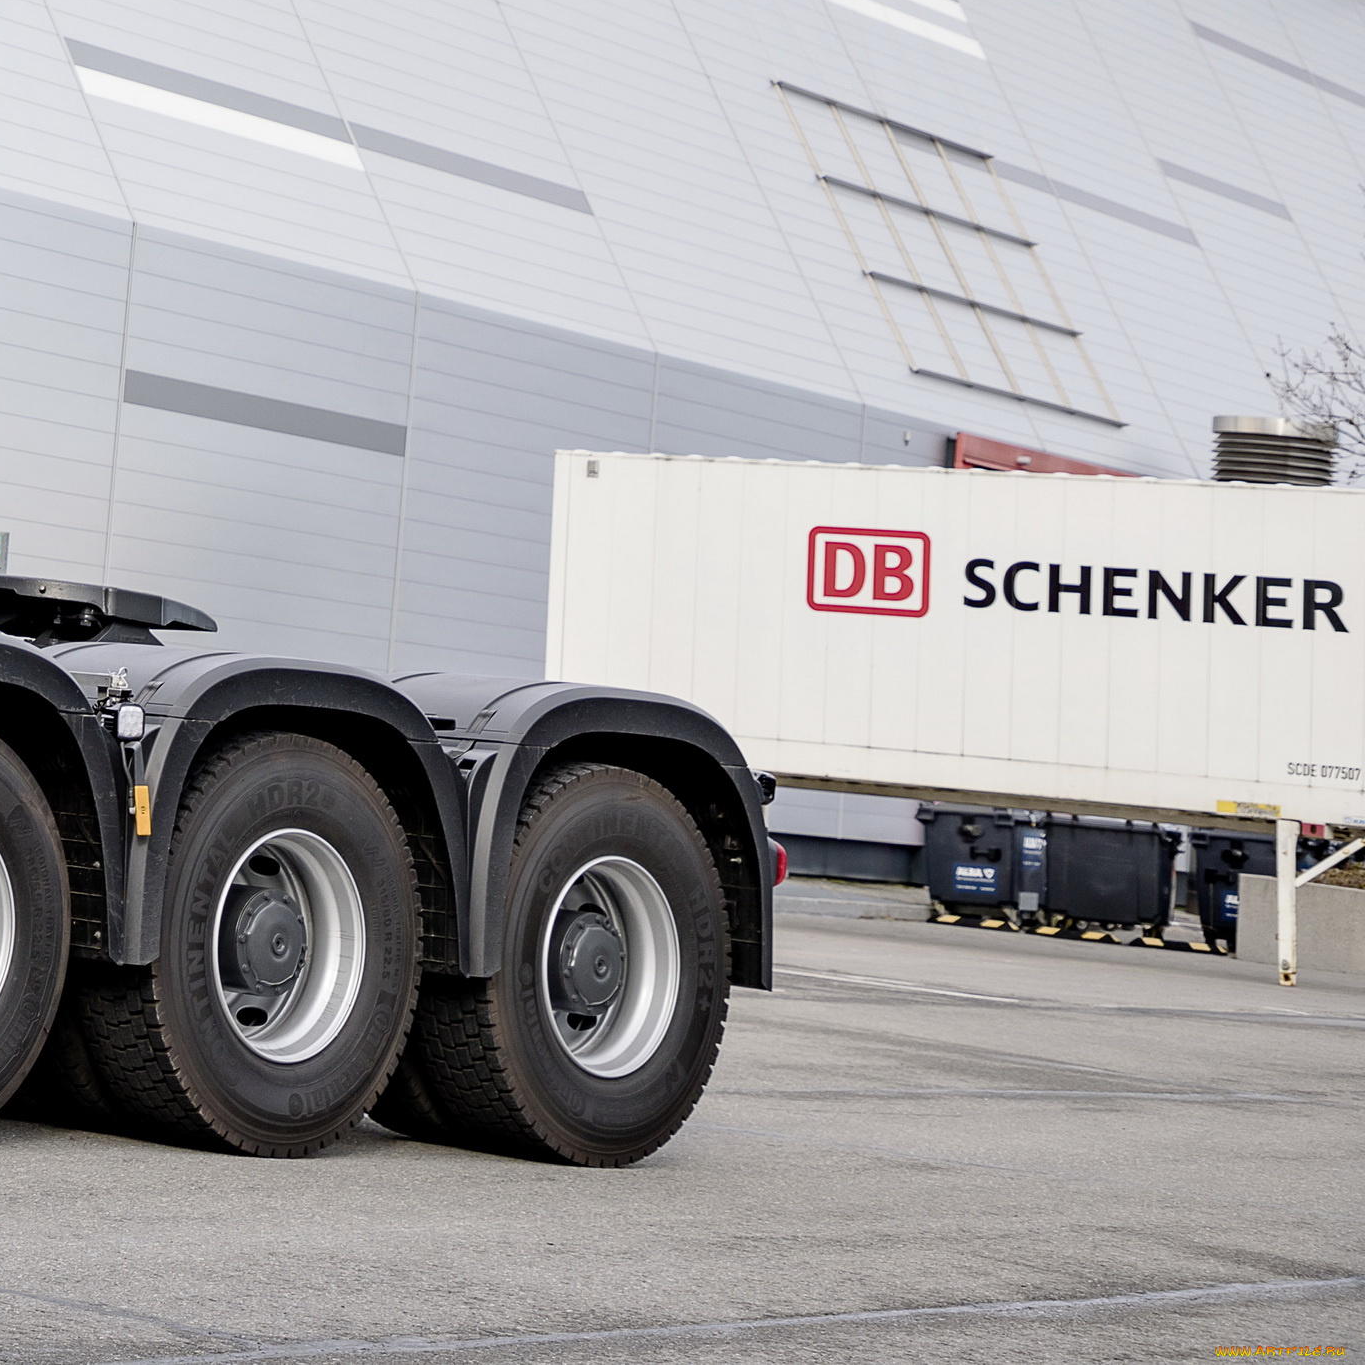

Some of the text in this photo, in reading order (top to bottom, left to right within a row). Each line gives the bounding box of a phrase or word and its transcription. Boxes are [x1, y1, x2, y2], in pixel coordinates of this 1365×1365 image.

[823, 541, 914, 602] DB
[962, 558, 1350, 633] SCHENKER
[1287, 762, 1361, 781] SCDE 077507
[382, 946, 392, 980] 22.5
